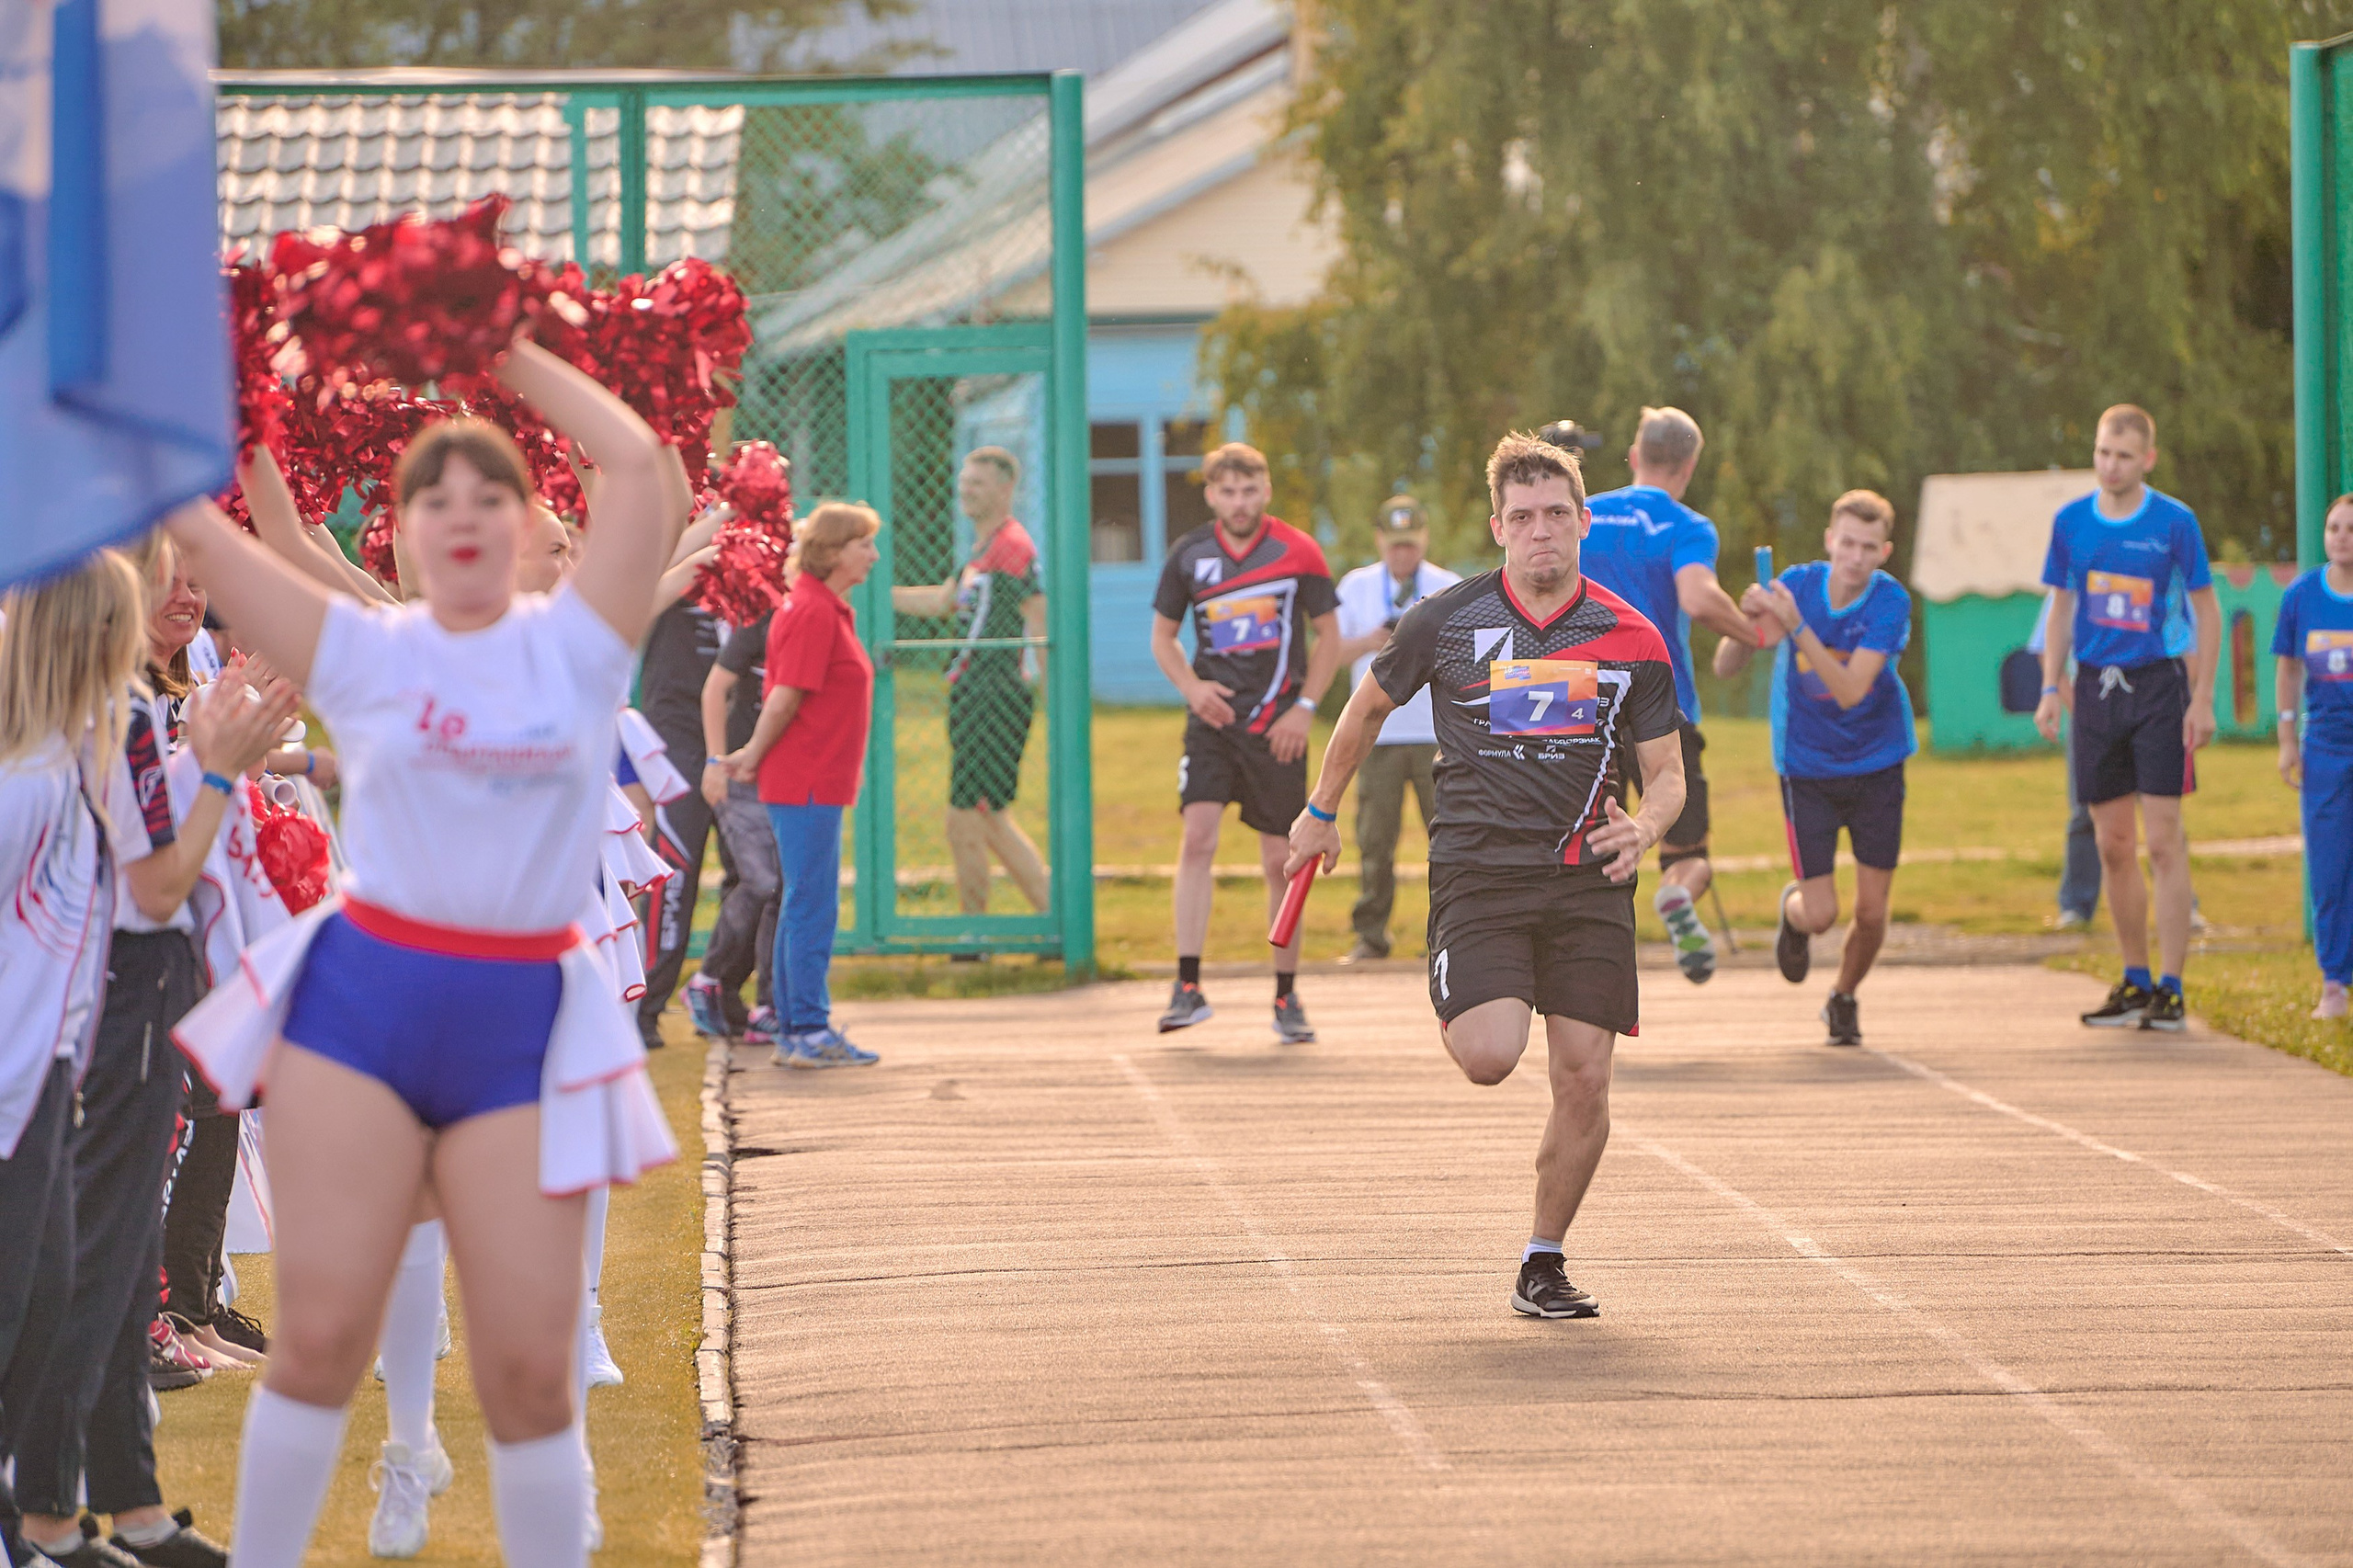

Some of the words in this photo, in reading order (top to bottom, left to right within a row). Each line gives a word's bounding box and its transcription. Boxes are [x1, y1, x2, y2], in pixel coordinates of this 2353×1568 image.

[1232, 618, 1251, 642] 7
[1528, 690, 1554, 722] 7
[1571, 708, 1584, 720] 4
[1478, 749, 1511, 758] ФОРМУЛА
